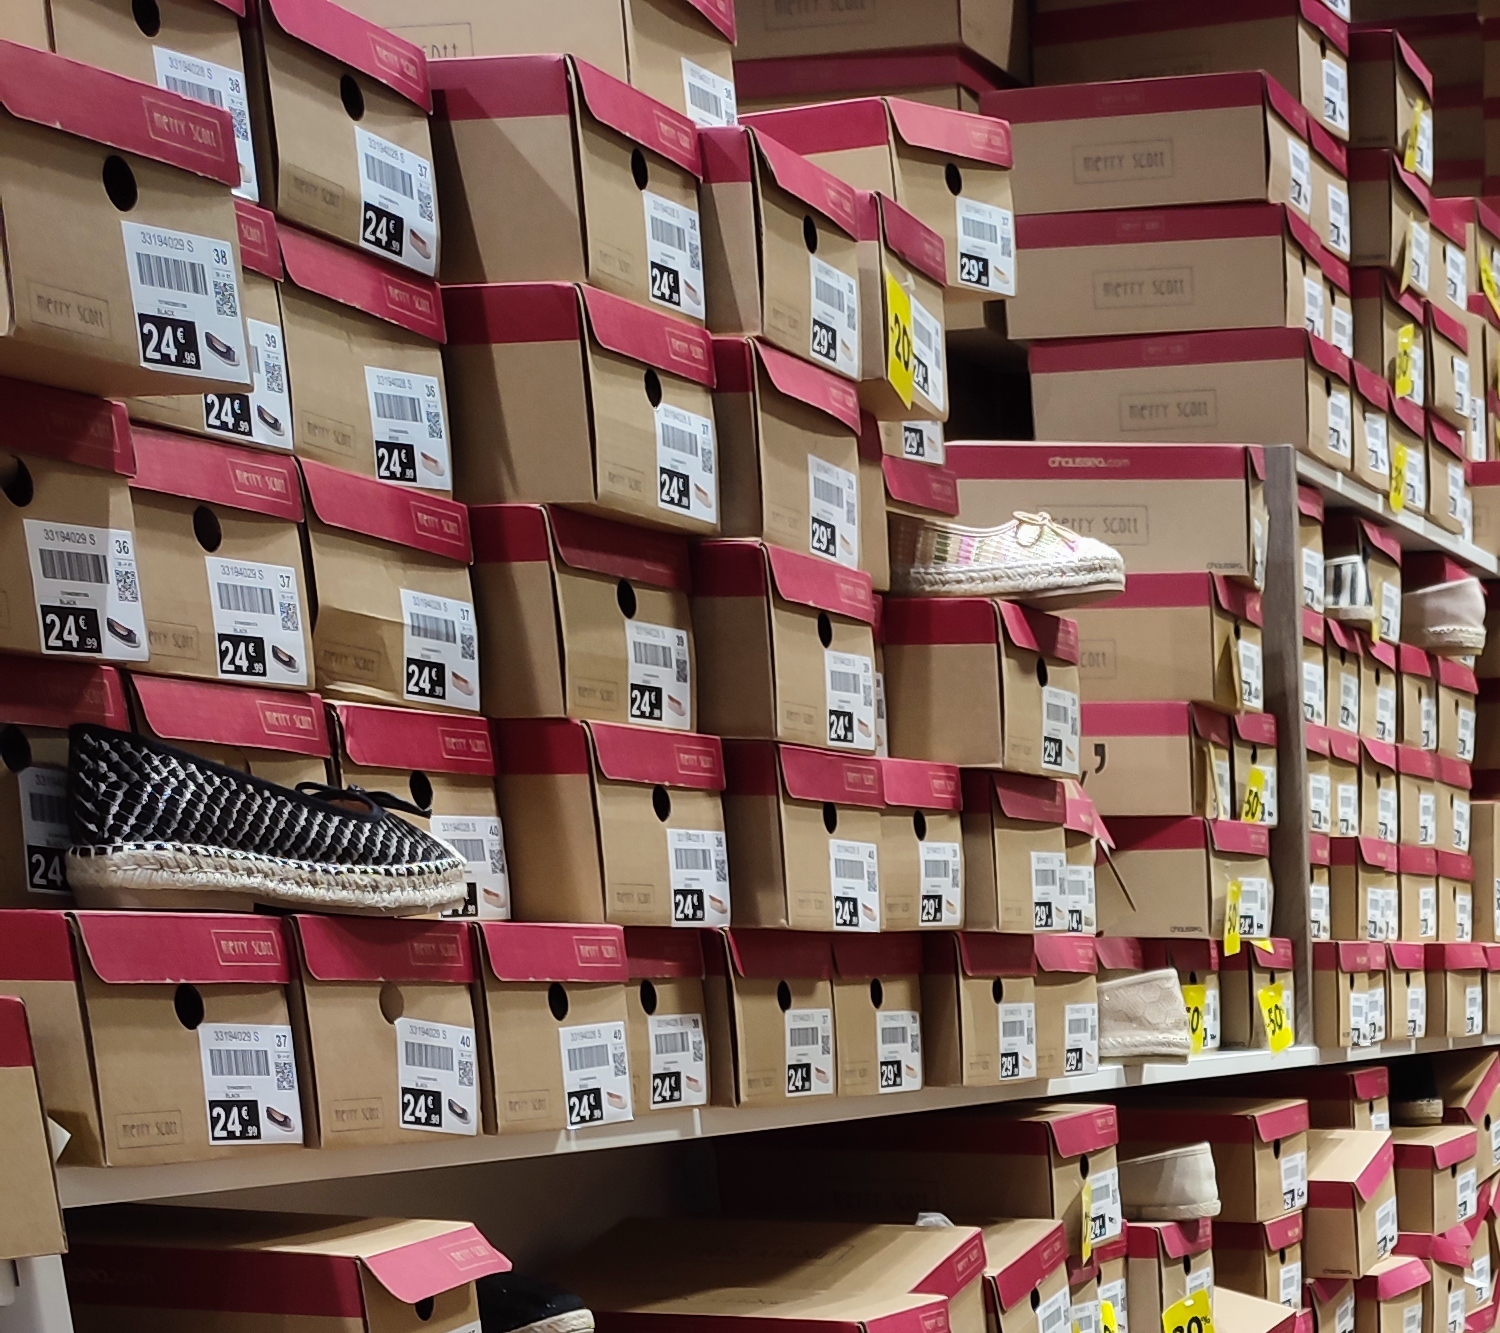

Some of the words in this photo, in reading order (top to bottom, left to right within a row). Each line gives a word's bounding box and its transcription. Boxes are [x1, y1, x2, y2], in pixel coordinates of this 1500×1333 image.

[229, 78, 241, 93] 38
[417, 164, 428, 178] 37
[140, 232, 184, 250] 33194029
[213, 249, 227, 265] 38
[265, 334, 276, 348] 39
[44, 529, 86, 544] 33194029
[115, 540, 129, 554] 36
[280, 574, 291, 588] 37
[276, 1035, 287, 1048] 37
[460, 1036, 471, 1048] 40
